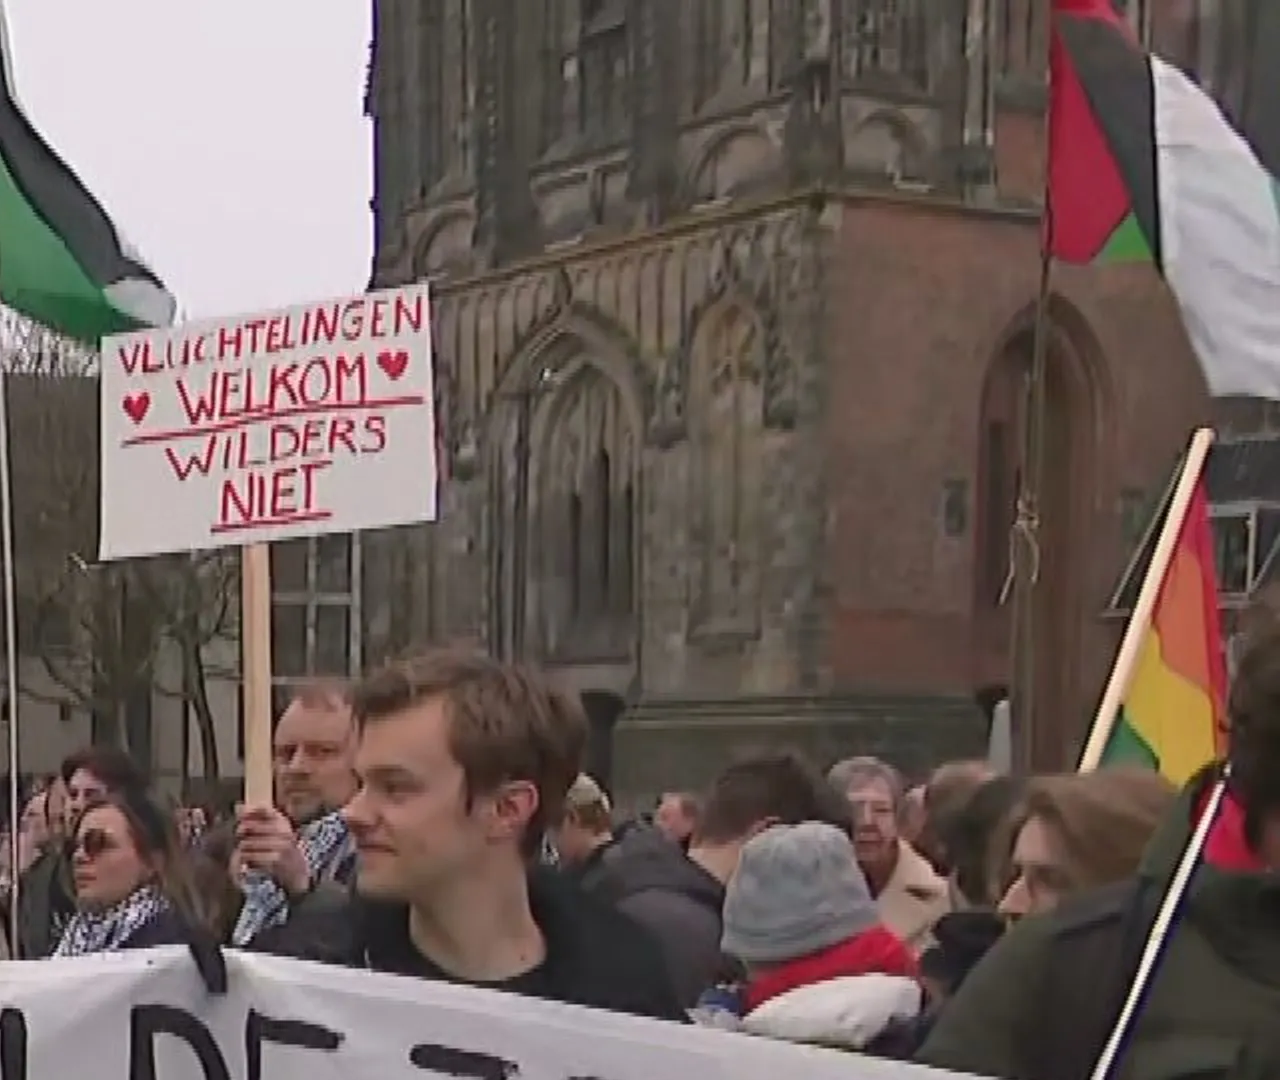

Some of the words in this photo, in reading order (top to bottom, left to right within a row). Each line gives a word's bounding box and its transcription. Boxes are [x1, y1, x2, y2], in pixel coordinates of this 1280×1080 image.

[119, 296, 422, 375] VLUCHTELINGEN
[176, 353, 366, 425] WELKOM
[165, 416, 386, 481] WILDERS
[222, 461, 333, 522] NIET
